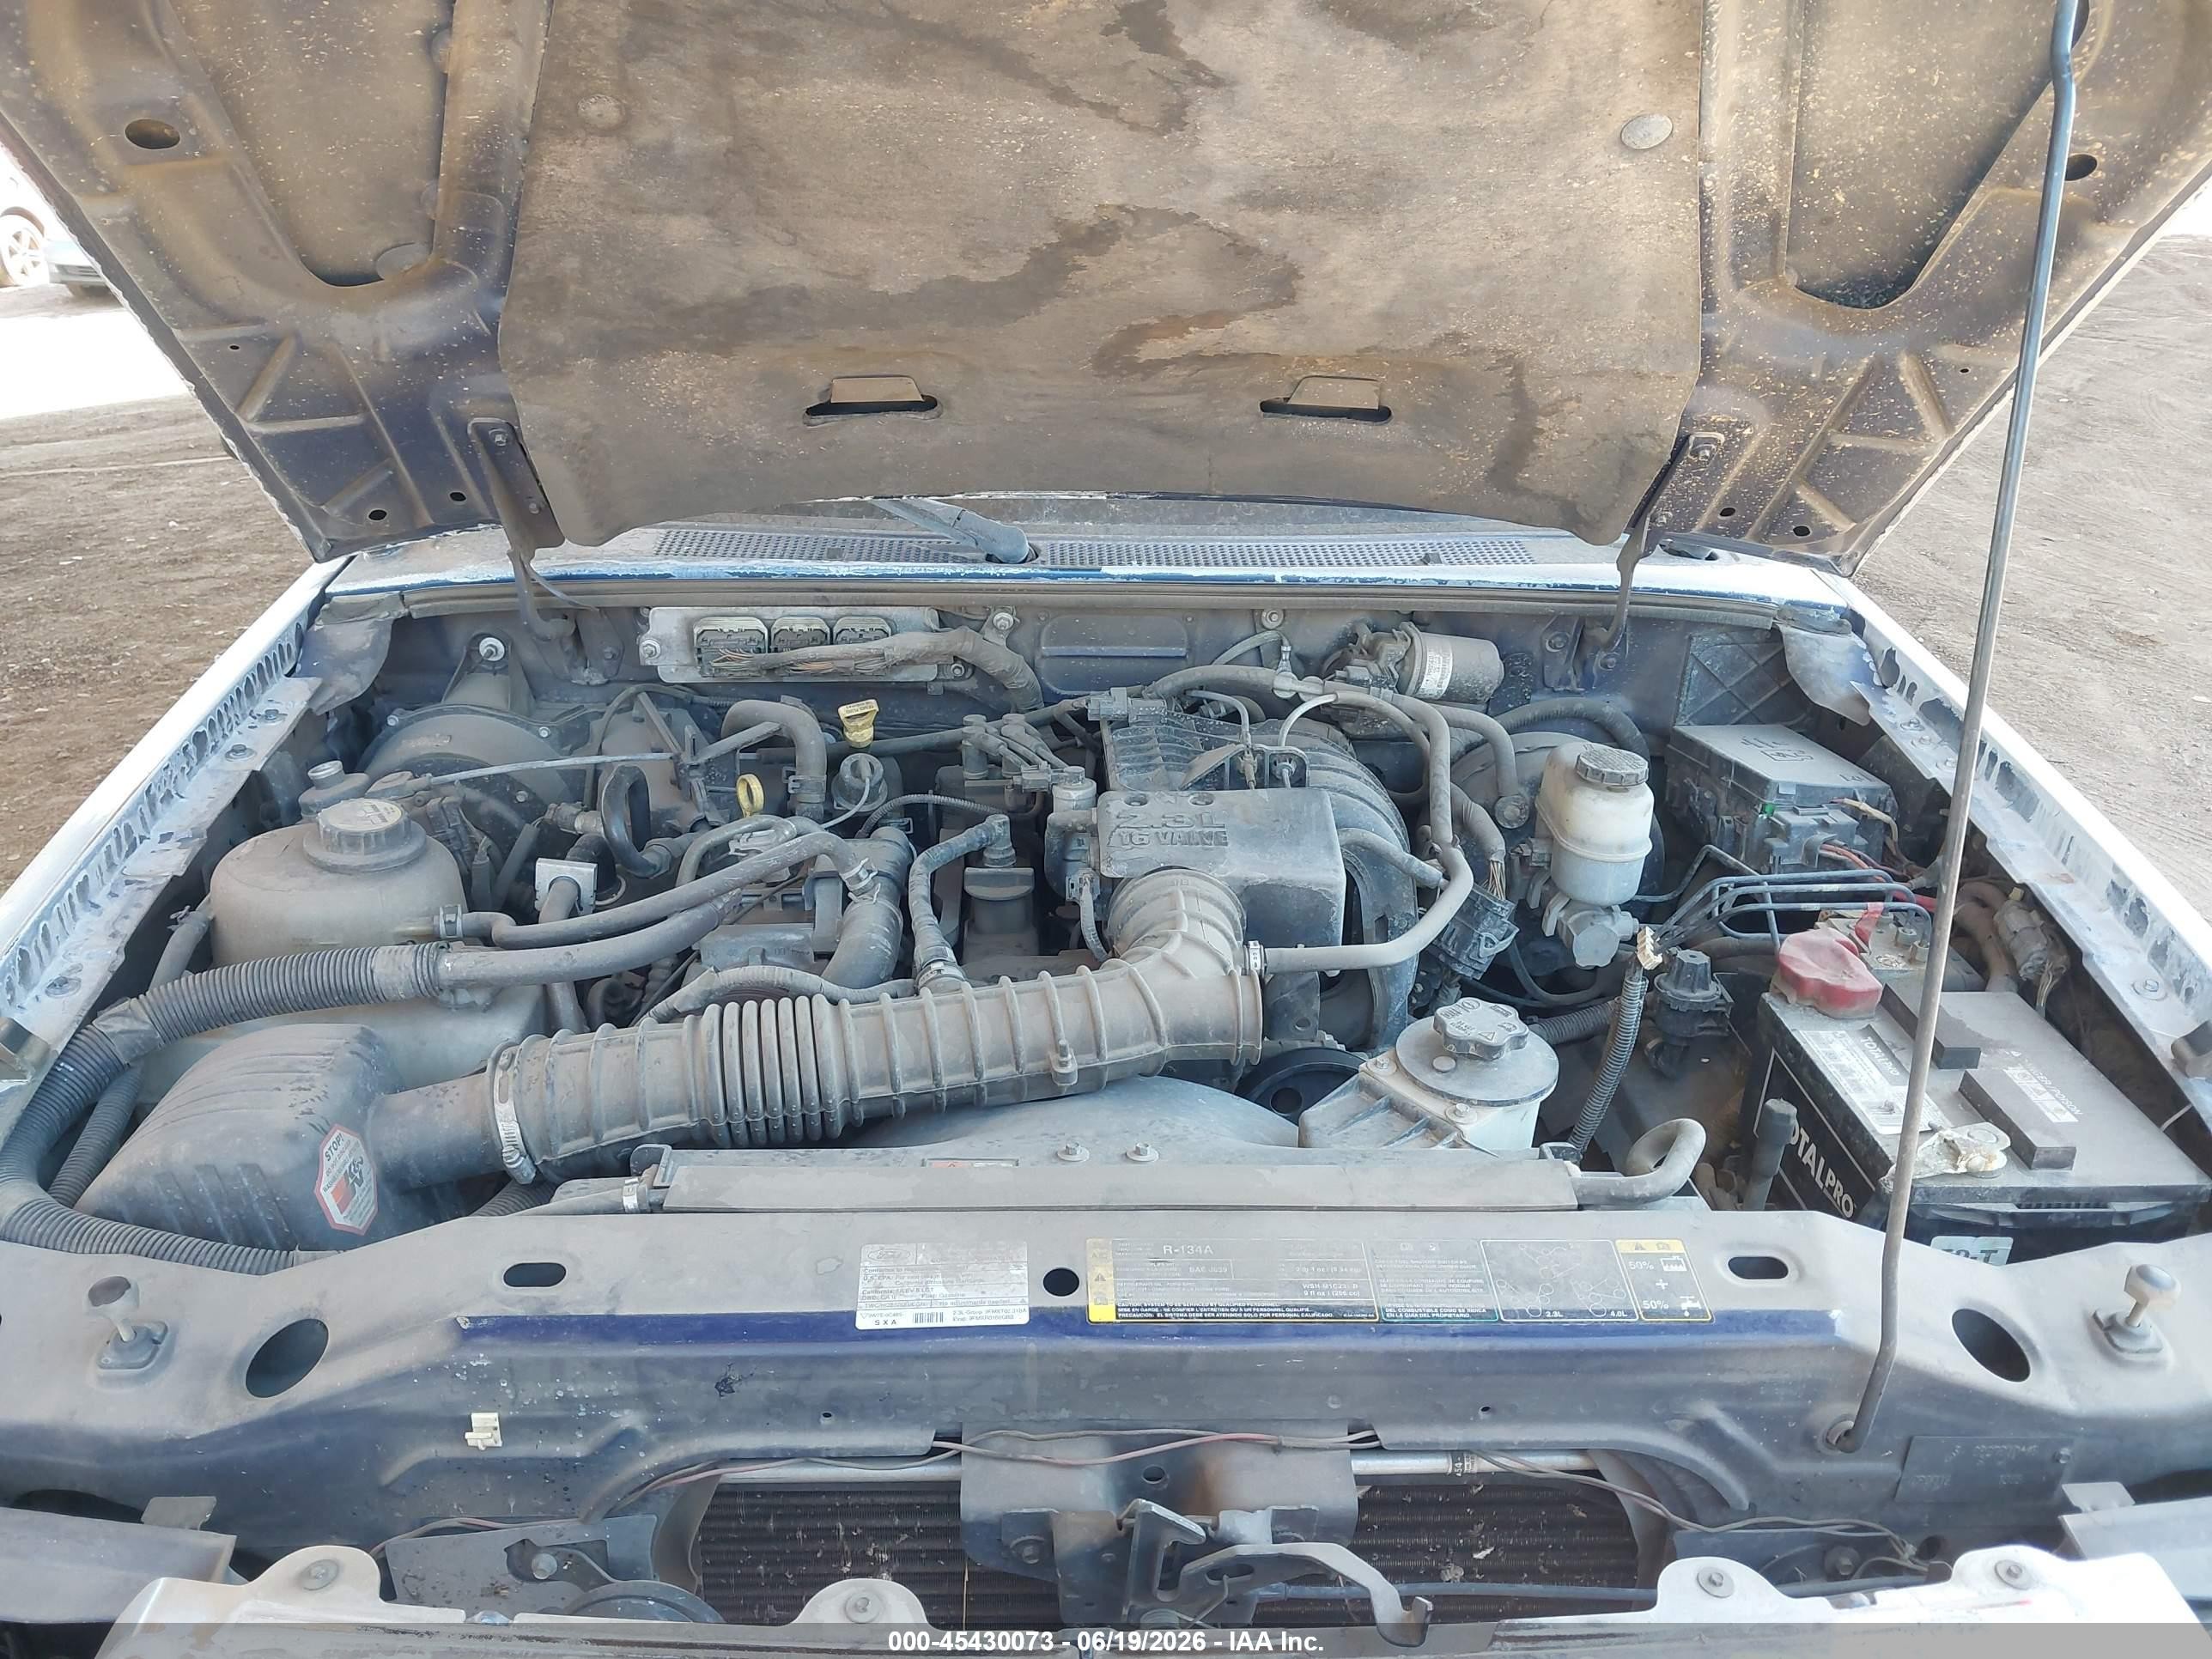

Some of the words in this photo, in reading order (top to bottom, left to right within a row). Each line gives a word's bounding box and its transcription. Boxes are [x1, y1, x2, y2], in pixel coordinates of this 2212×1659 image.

[1115, 811, 1226, 829] 2.3L
[325, 1133, 344, 1162] STOP!
[1790, 1124, 1854, 1218] OTALPRO
[1163, 1245, 1214, 1255] R-134A
[1628, 1261, 1655, 1270] 50%
[1642, 1300, 1669, 1310] 50%
